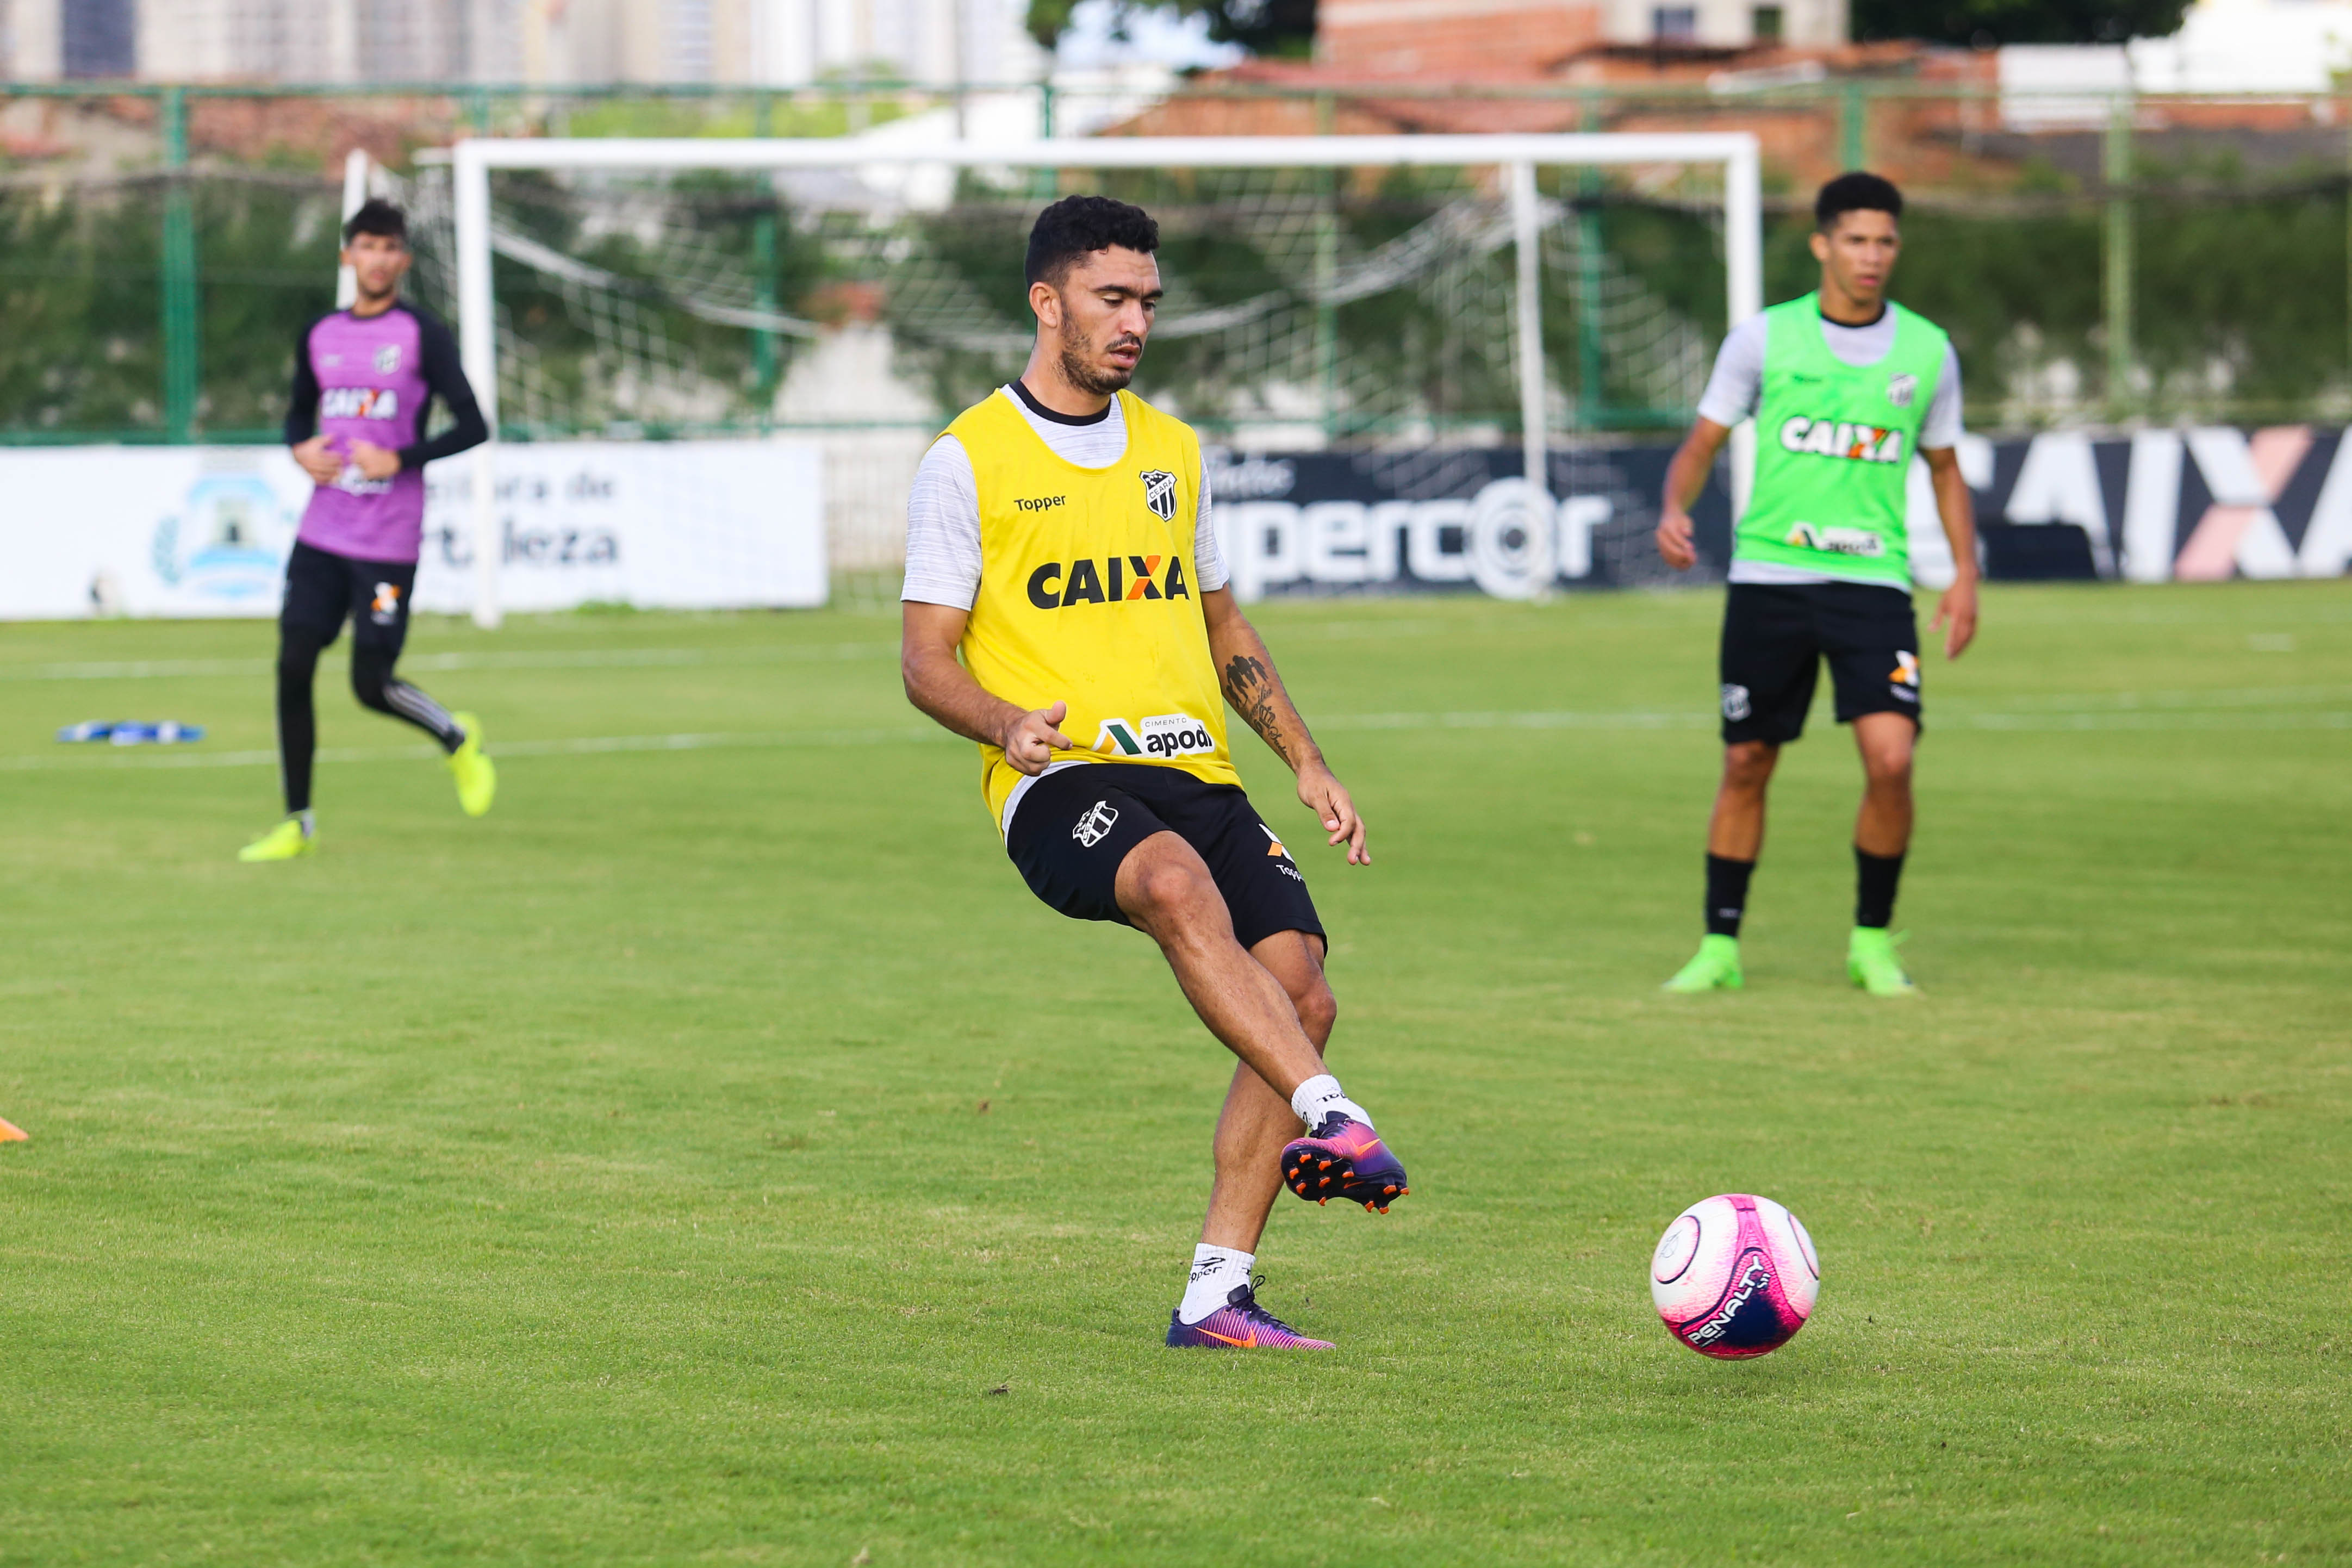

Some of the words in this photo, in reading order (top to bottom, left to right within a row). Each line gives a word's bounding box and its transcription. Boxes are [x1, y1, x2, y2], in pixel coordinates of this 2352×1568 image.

[1781, 415, 1902, 462] CAIXA
[1014, 495, 1066, 512] Topper
[1217, 477, 1614, 602] percor
[1027, 555, 1190, 609] CAIXA
[1145, 718, 1186, 727] CIMENTO
[1688, 1255, 1764, 1344] PENALTY
